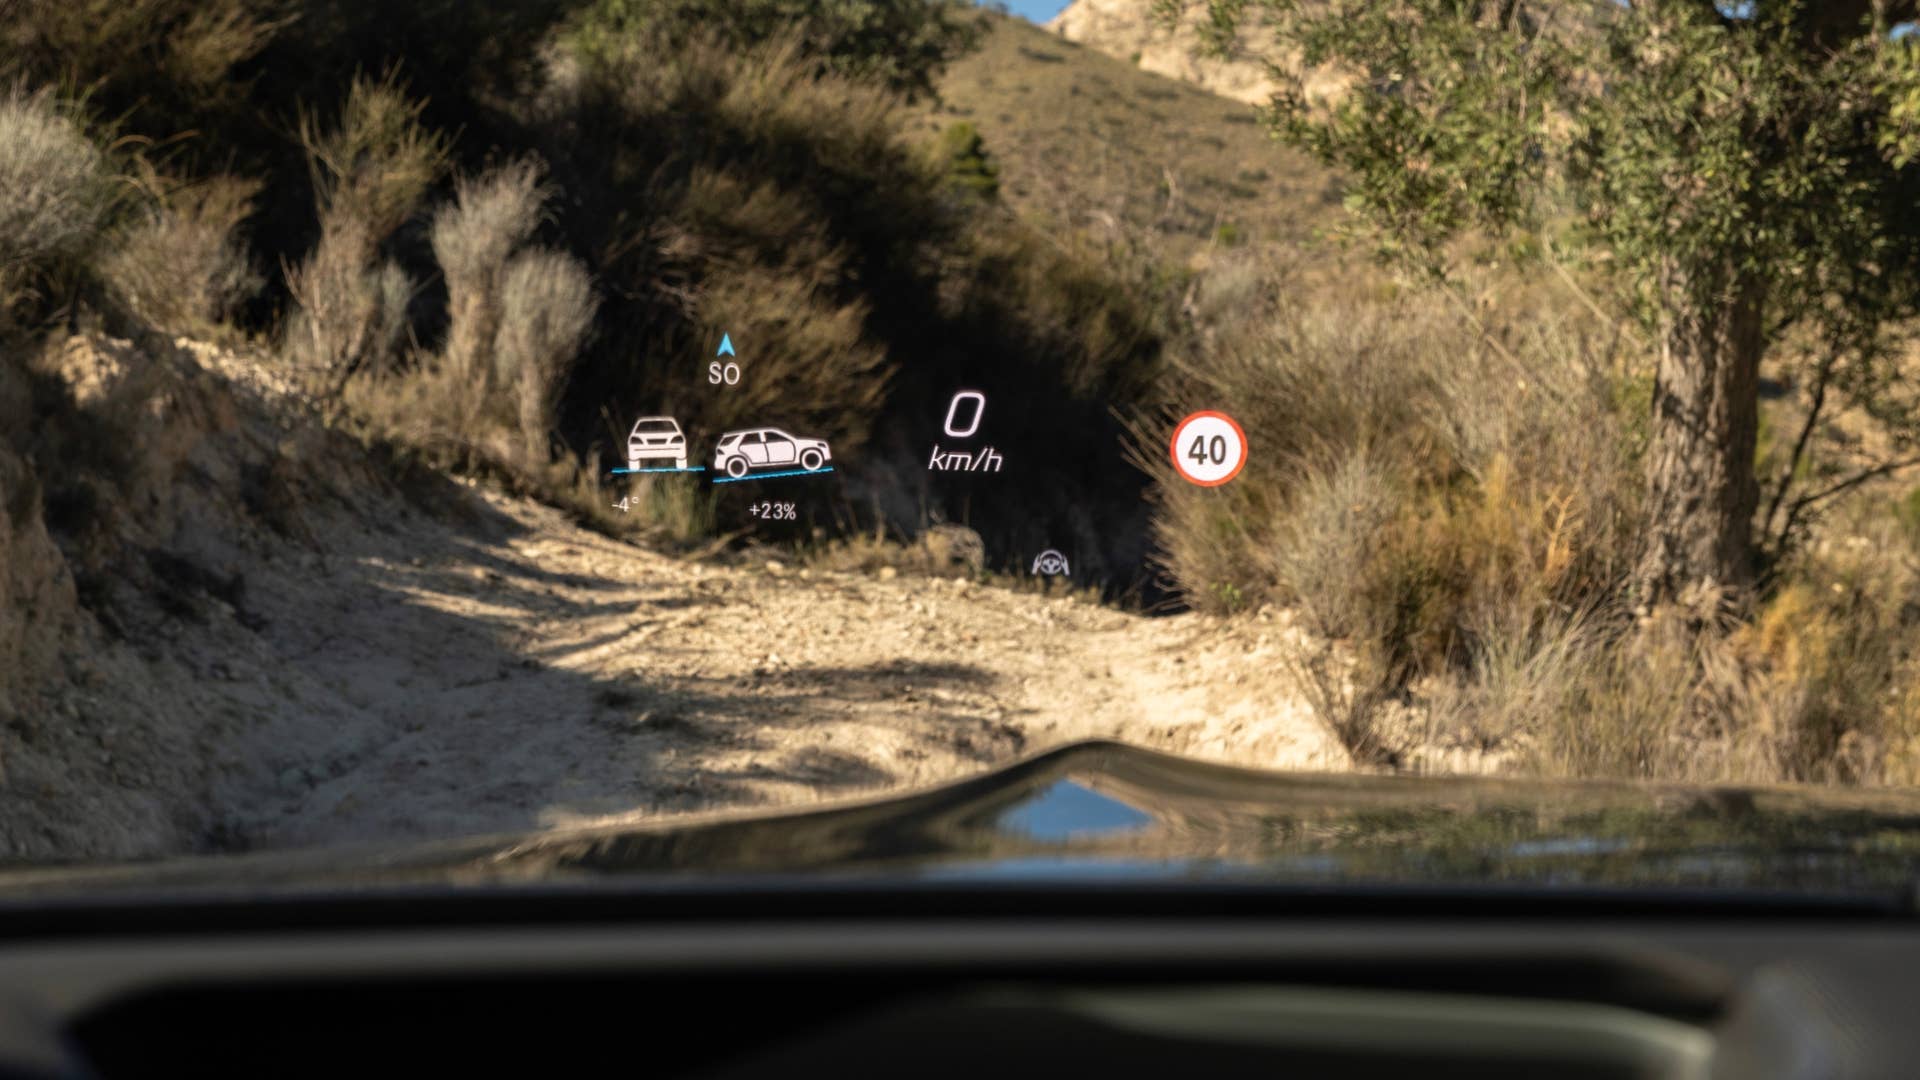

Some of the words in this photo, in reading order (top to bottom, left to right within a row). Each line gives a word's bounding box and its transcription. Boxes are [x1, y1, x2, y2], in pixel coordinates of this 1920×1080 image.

[708, 361, 741, 386] SO
[944, 391, 986, 438] 0
[928, 445, 1003, 472] km/h
[1188, 435, 1227, 465] 40
[749, 503, 797, 520] +23%
